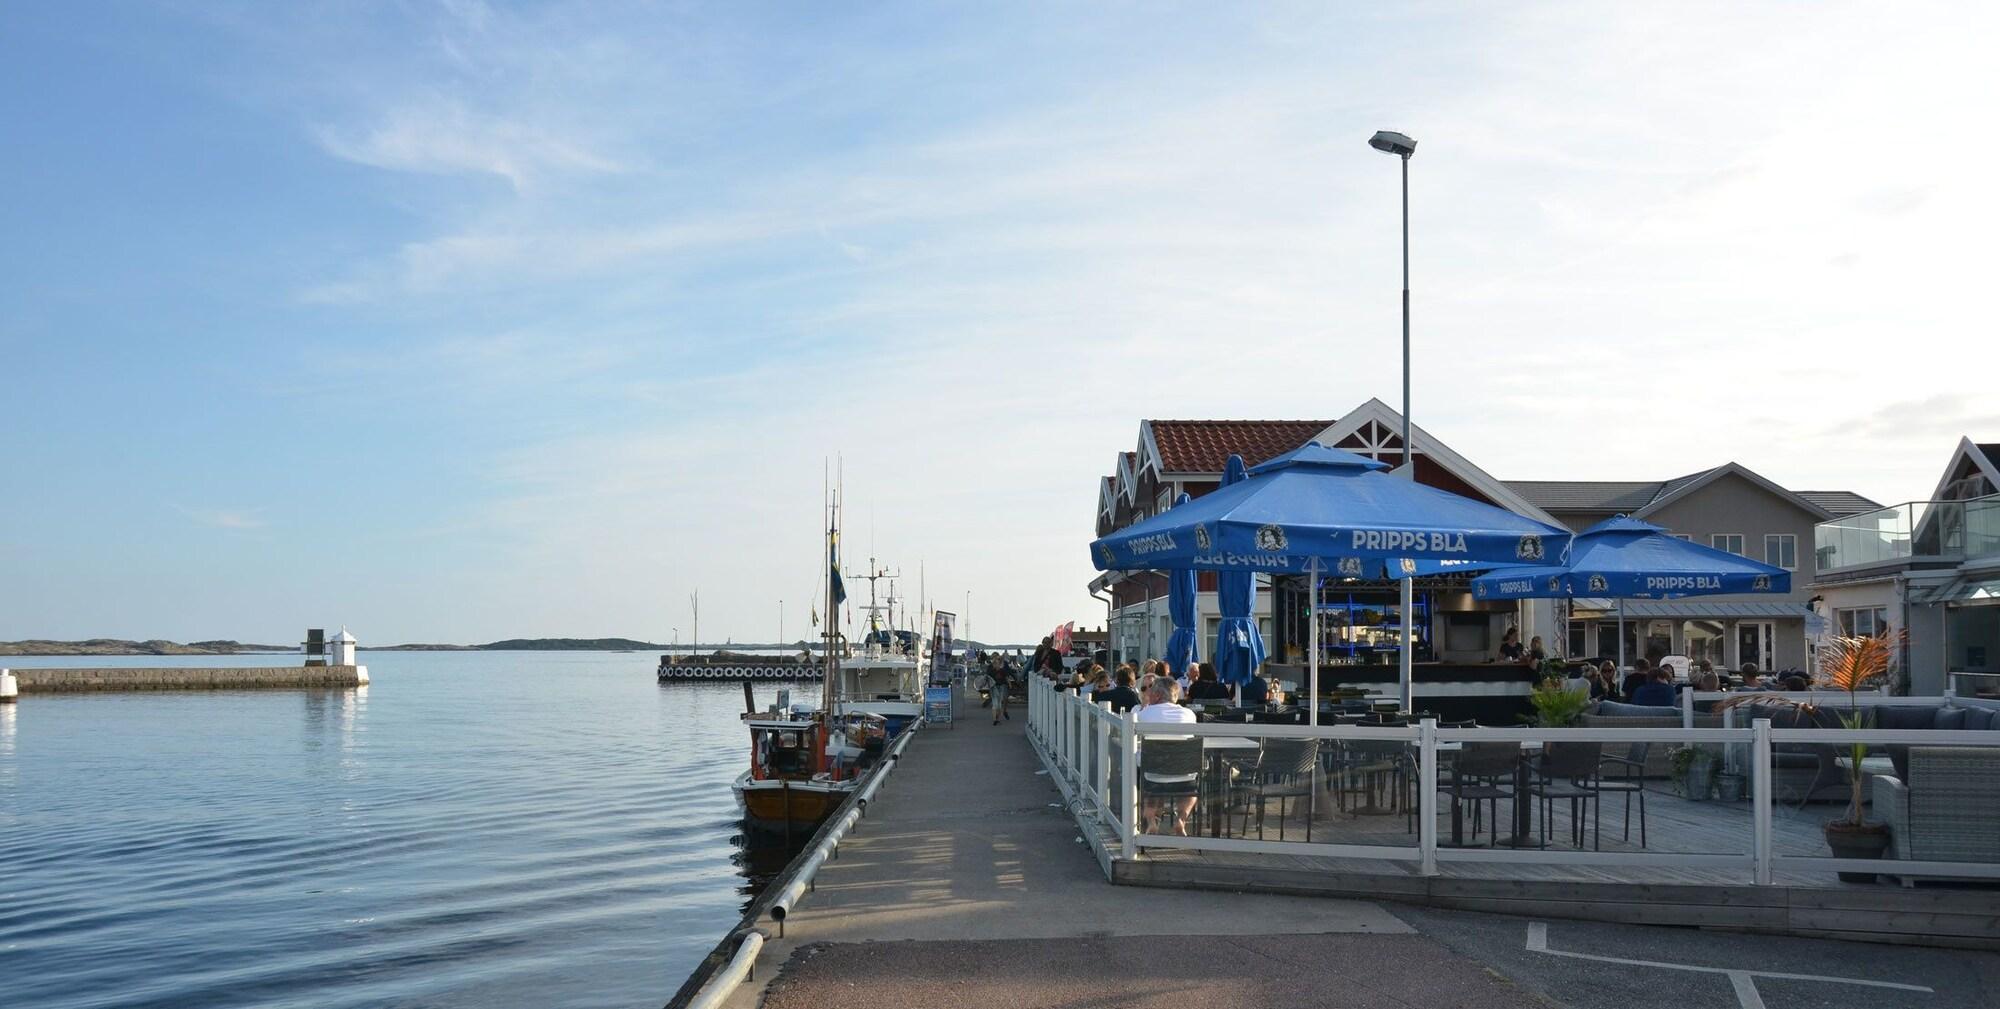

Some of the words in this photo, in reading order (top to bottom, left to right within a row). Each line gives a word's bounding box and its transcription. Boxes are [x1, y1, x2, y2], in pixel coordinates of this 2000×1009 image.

[1128, 535, 1160, 555] PRIPPS
[1352, 530, 1428, 551] PRIPPS
[1431, 533, 1468, 552] BLÅ
[1499, 582, 1522, 593] PRIPPS
[1647, 576, 1695, 589] PRIPPS
[1696, 575, 1721, 588] BLÅ
